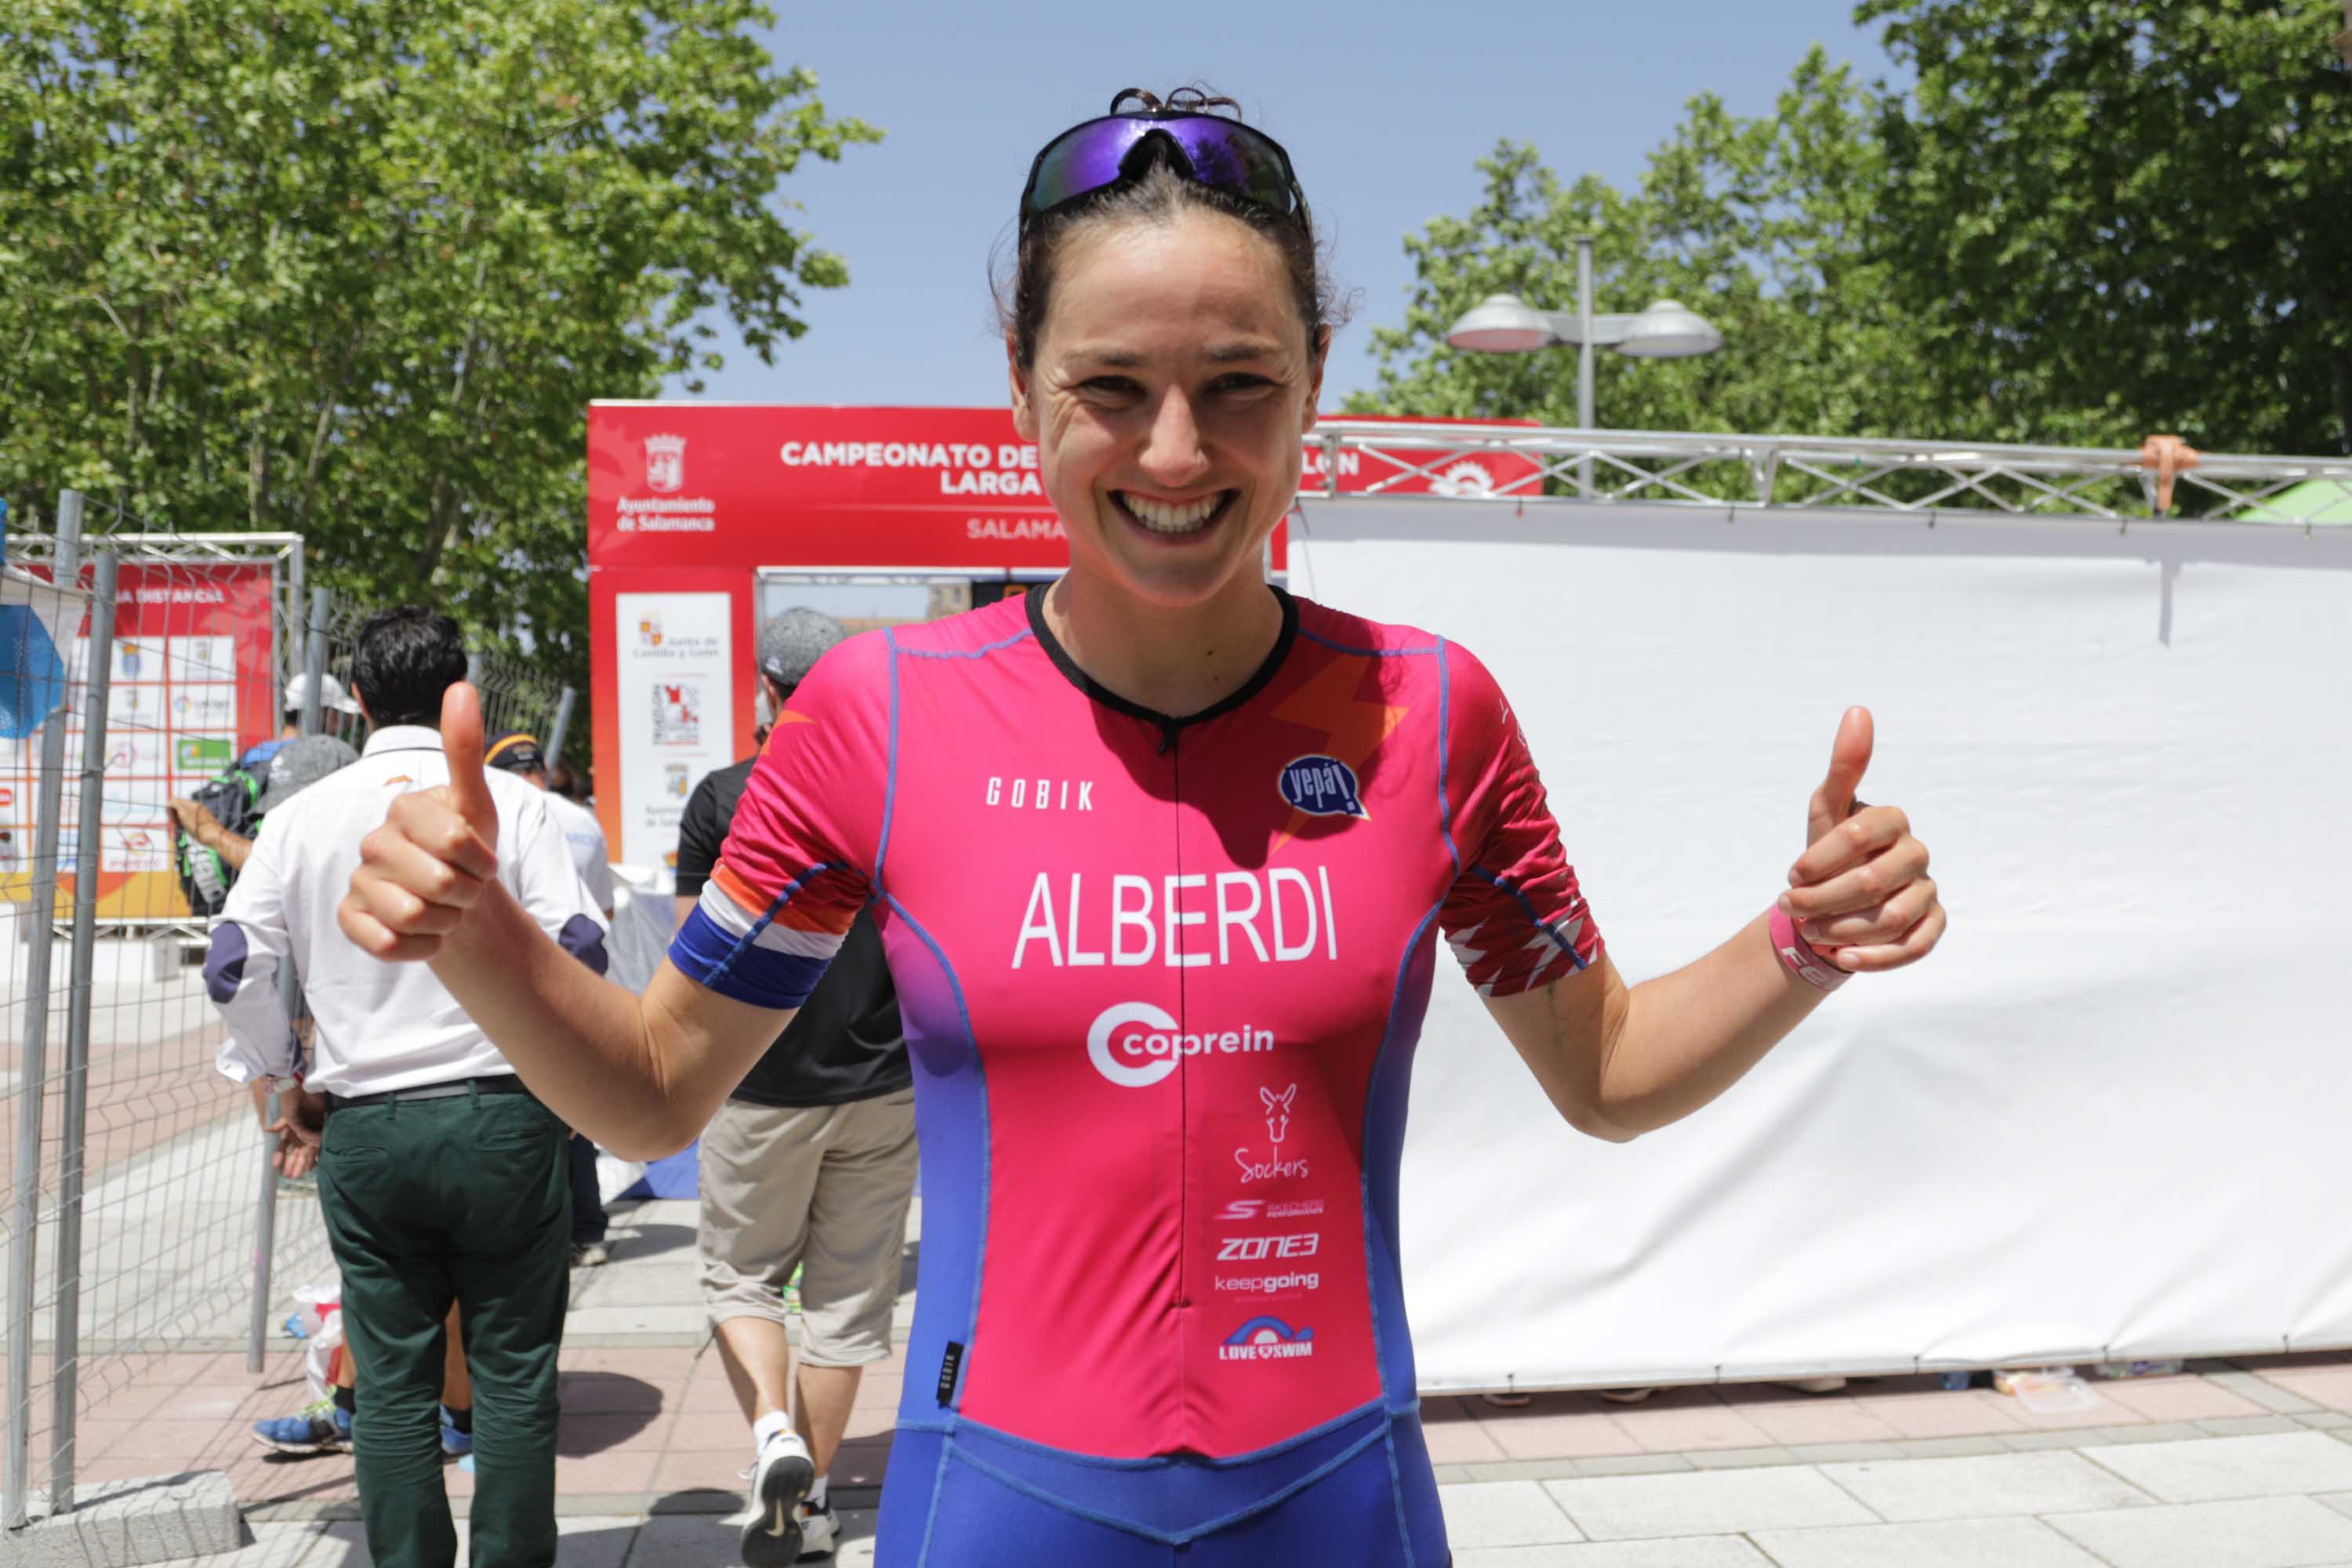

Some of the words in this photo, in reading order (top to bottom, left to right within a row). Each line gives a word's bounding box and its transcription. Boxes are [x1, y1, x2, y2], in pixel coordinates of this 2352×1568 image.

[780, 440, 992, 469] CAMPEONATO
[998, 445, 1038, 469] DE
[941, 470, 1042, 495] LARGA
[617, 495, 715, 514] Ayuntamiento
[617, 514, 635, 532] de
[639, 514, 715, 532] Salamanca
[985, 776, 1094, 811] GOBIK
[1289, 762, 1356, 811] yepá!
[1011, 866, 1338, 969] ALBERDI
[1123, 1025, 1274, 1062] coprein
[1235, 1145, 1308, 1183] Sockers
[1217, 1232, 1319, 1261] ZONE3
[1214, 1271, 1319, 1293] keepgoing
